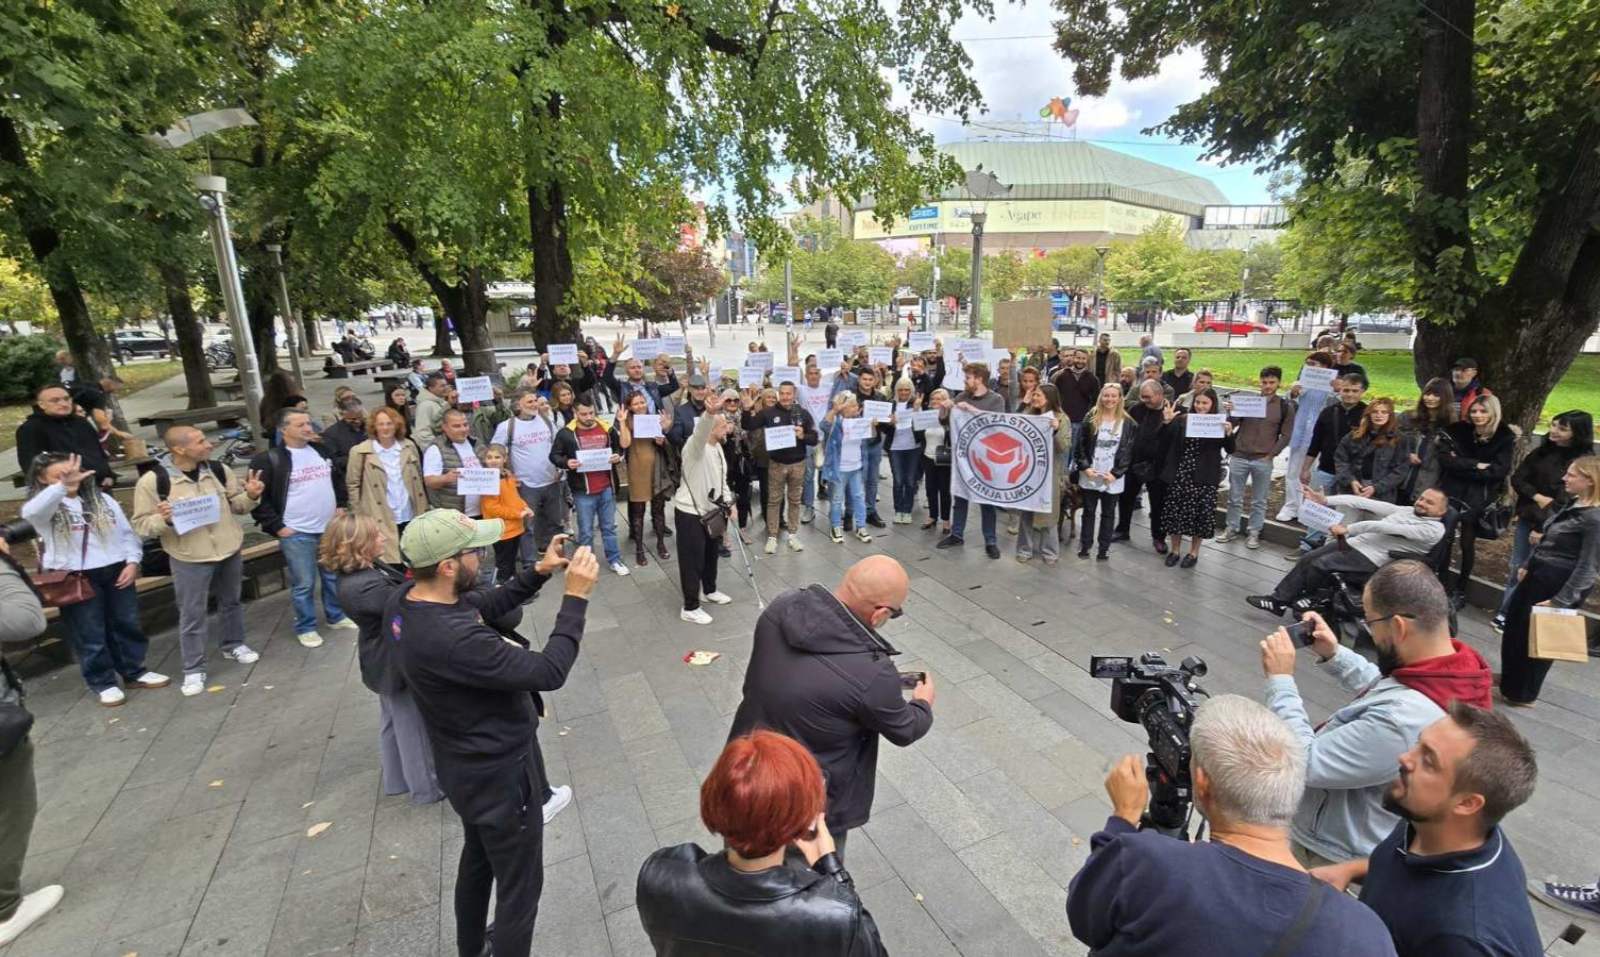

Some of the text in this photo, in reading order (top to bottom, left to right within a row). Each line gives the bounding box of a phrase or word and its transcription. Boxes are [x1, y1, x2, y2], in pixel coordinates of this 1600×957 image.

[958, 414, 1046, 468] STUDENTI ZA STUDENTE
[967, 477, 1033, 501] BANJA LUKA
